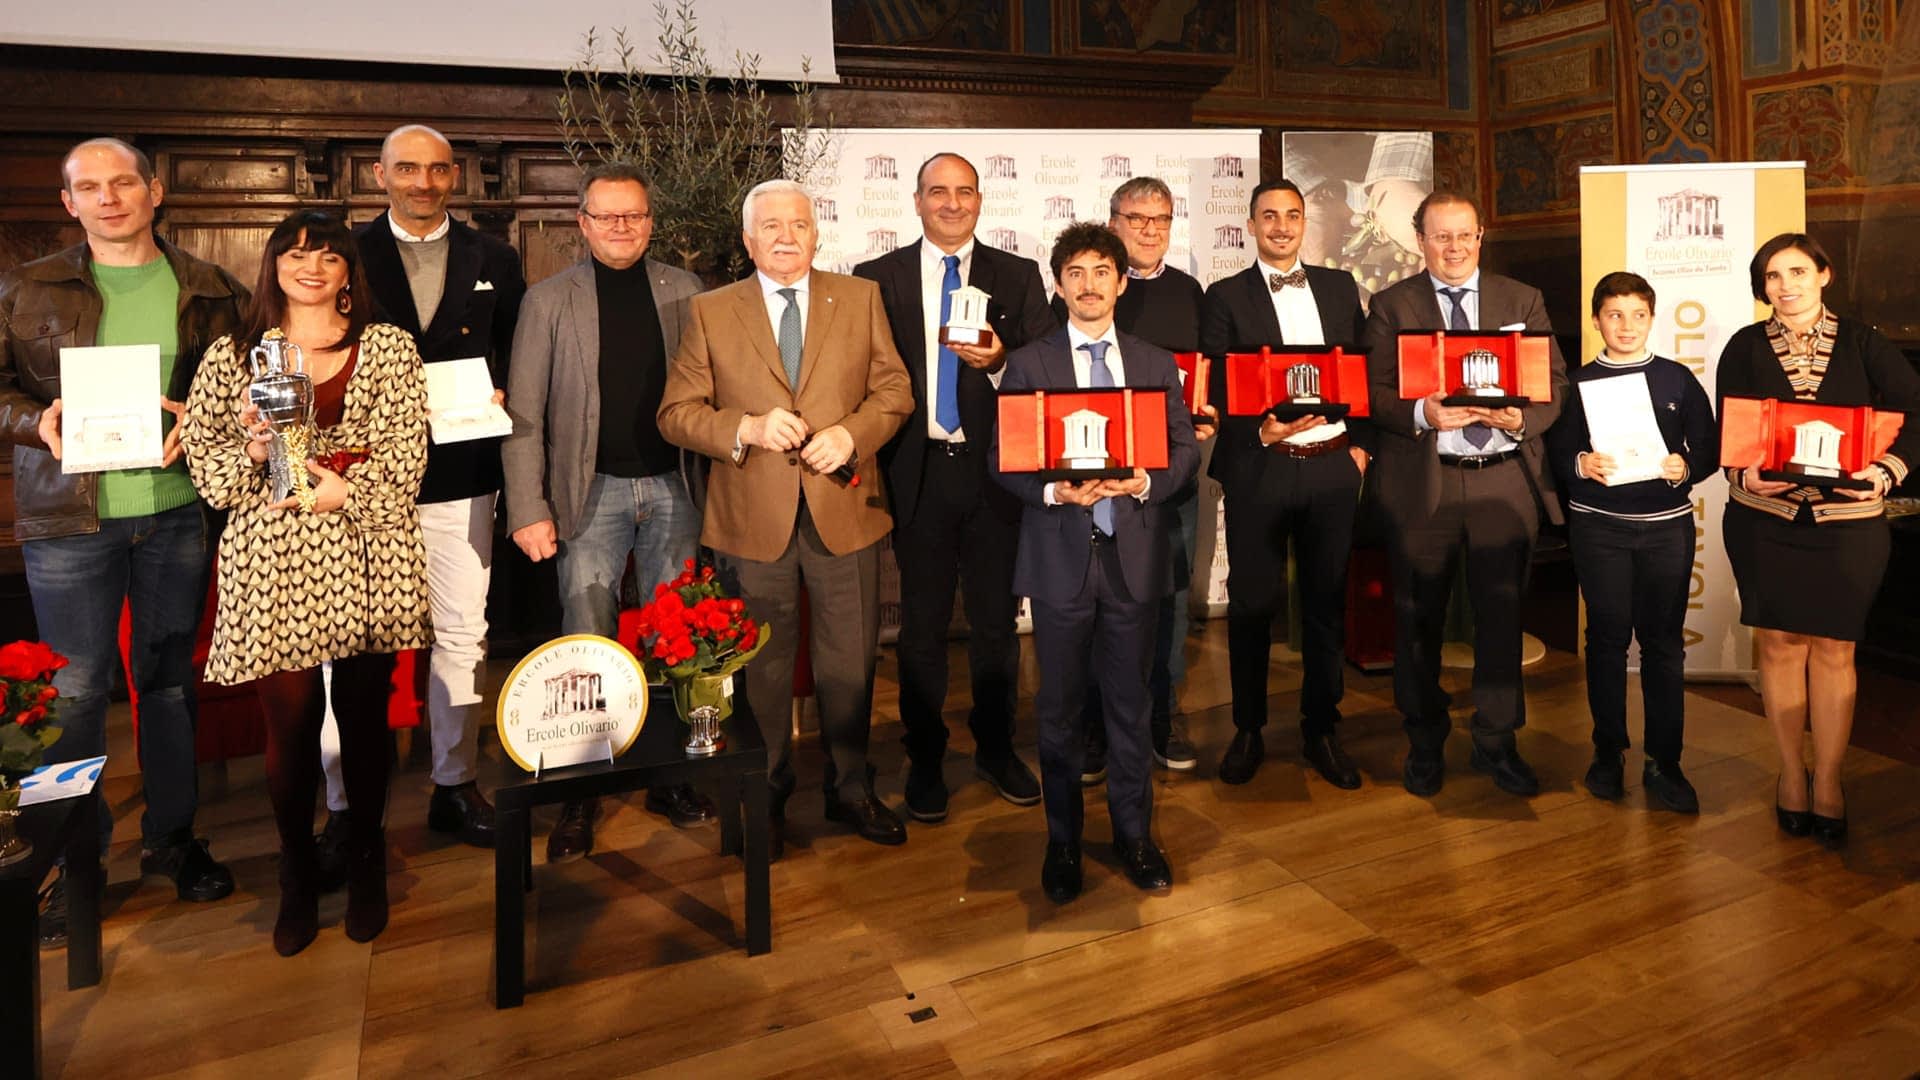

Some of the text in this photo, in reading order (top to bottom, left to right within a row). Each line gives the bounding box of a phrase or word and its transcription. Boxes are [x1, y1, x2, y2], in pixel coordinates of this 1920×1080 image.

[1041, 154, 1076, 169] Ercole
[1155, 153, 1189, 168] Ercole
[1034, 171, 1079, 186] Olivario
[863, 186, 899, 201] Ercole
[983, 185, 1018, 200] Ercole
[1210, 184, 1245, 199] Ercole
[856, 202, 902, 218] Olivario
[982, 201, 1019, 216] livario
[1205, 200, 1248, 215] Olivario
[1645, 244, 1732, 261] Ercole Olivario
[1212, 255, 1245, 270] Ercole
[513, 650, 562, 698] ERCOLE
[526, 724, 567, 744] Ercole
[569, 717, 619, 737] Olivario
